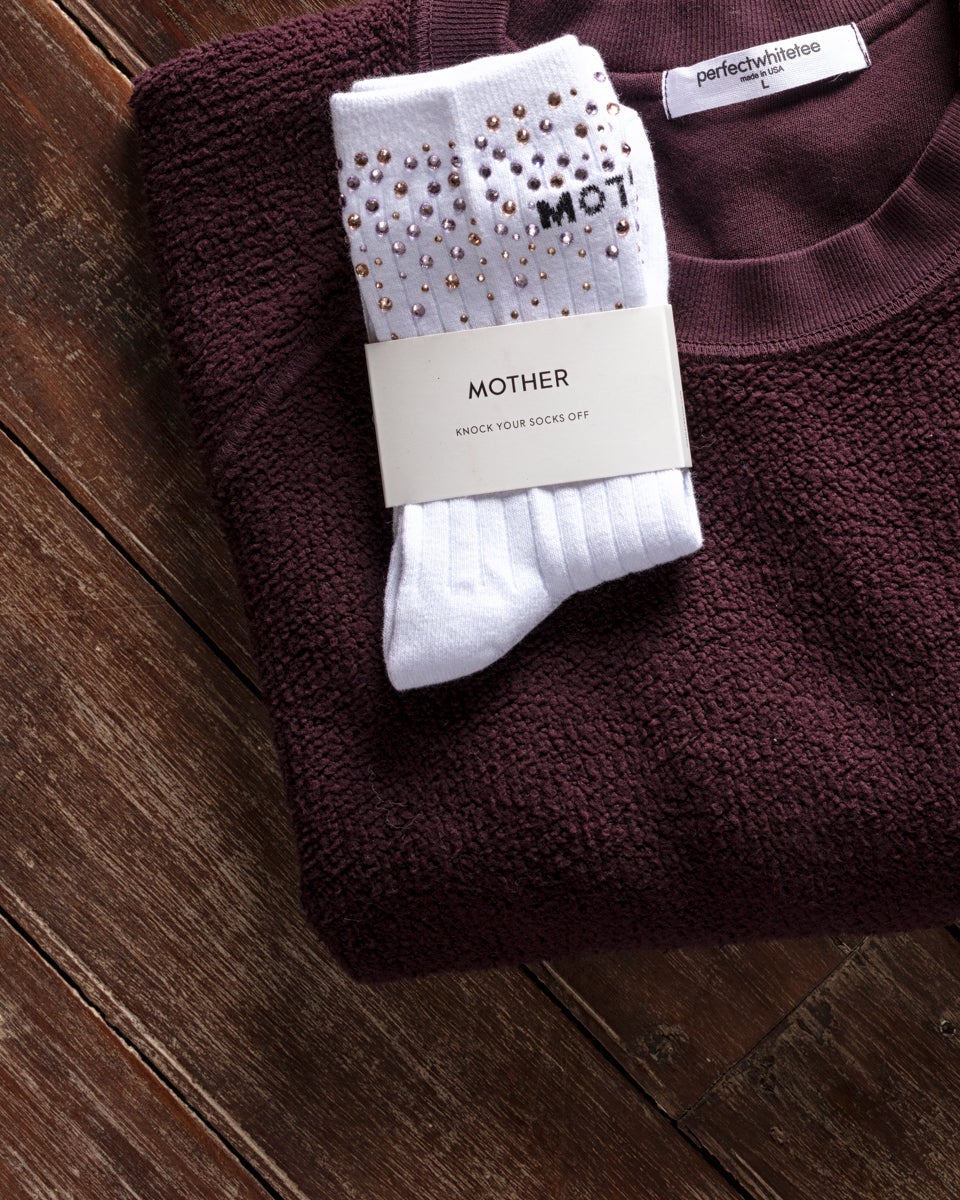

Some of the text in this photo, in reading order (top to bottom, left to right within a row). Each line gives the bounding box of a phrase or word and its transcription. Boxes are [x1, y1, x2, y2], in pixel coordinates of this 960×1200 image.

[697, 42, 821, 87] perfectwhitetee
[740, 65, 784, 83] made in USA
[761, 80, 770, 90] L
[469, 369, 569, 399] MOTHER
[455, 410, 589, 436] KNOCK YOUR SOCKS OFF
